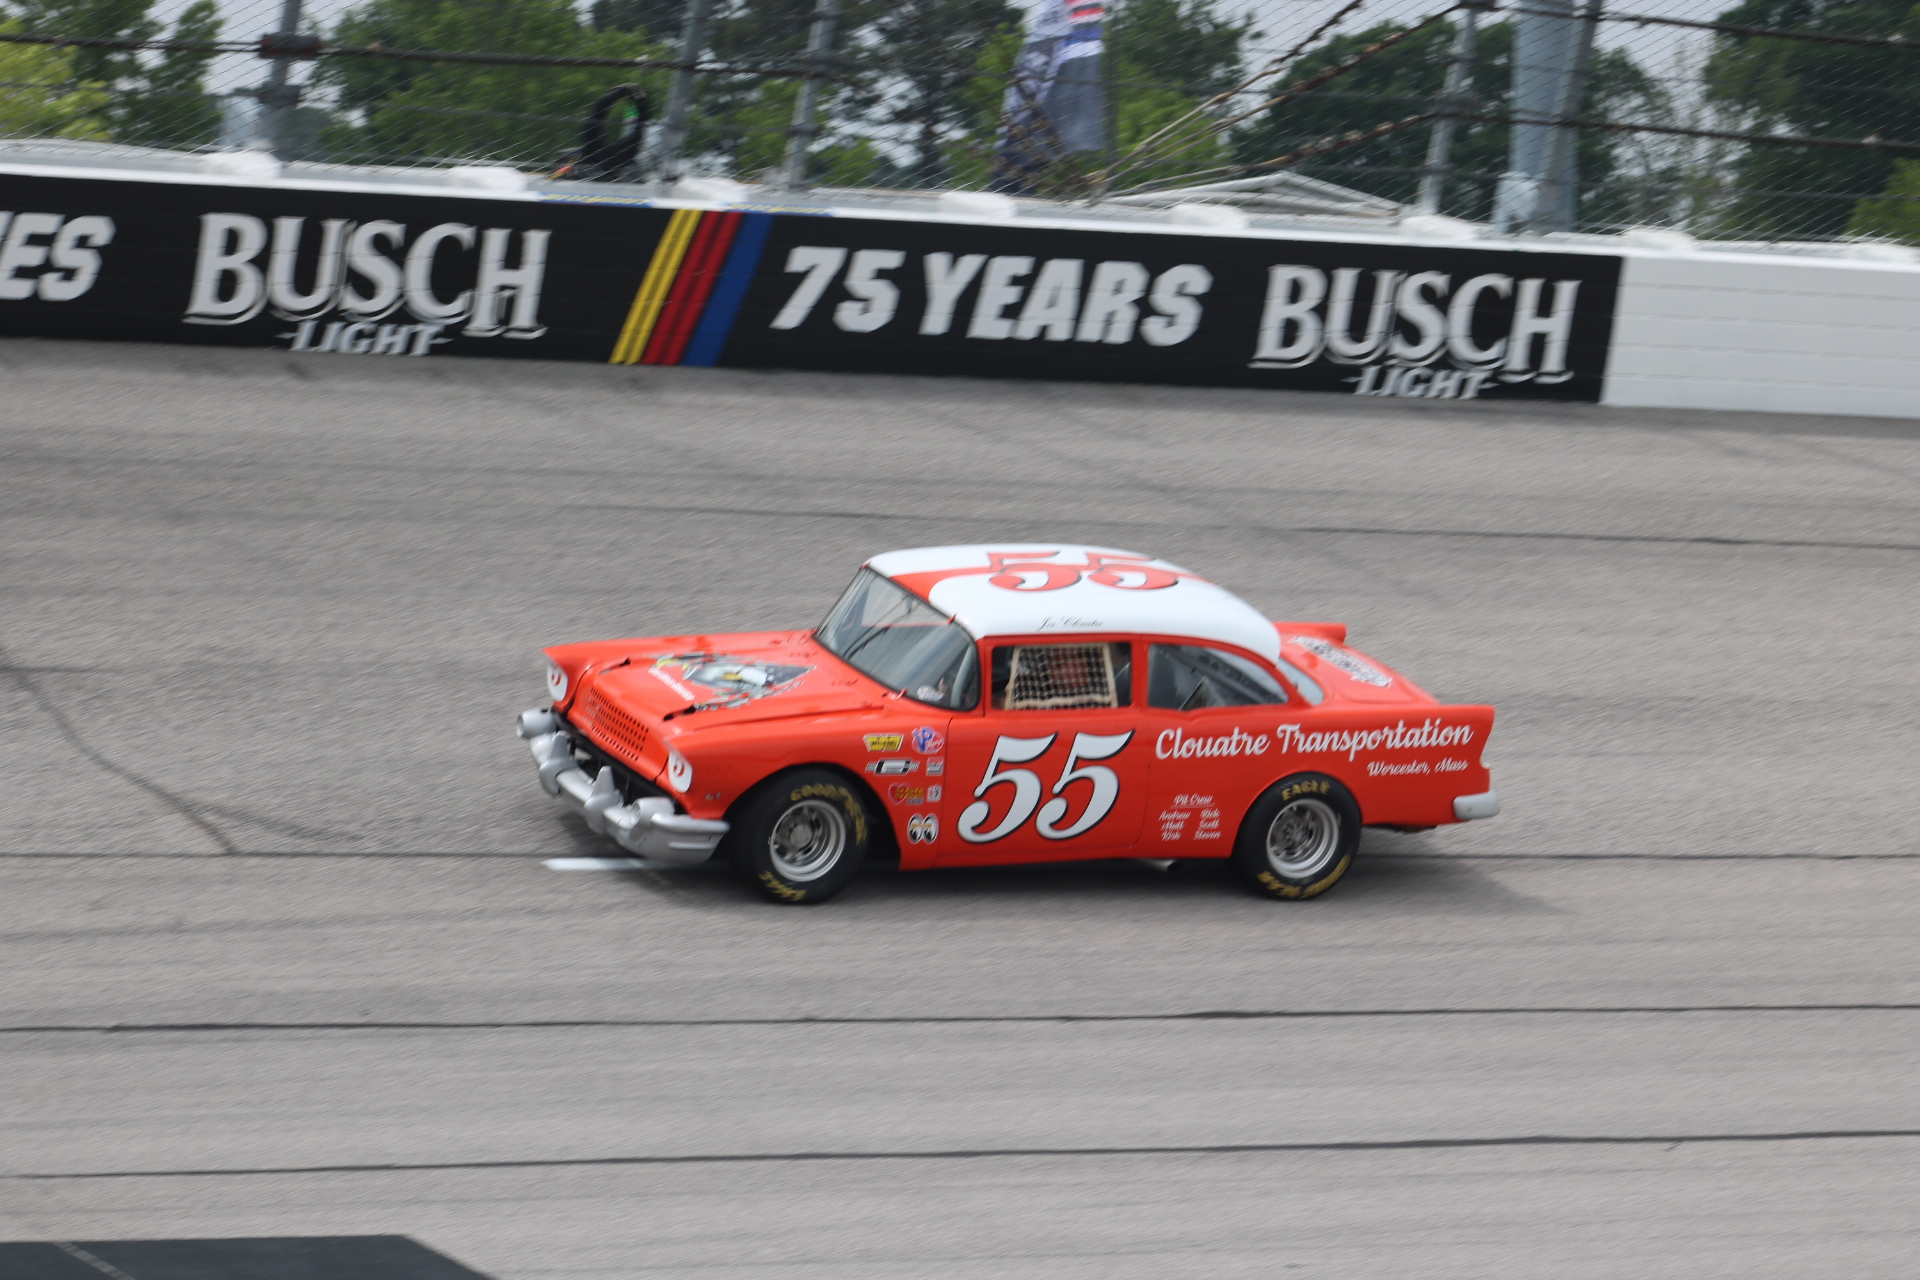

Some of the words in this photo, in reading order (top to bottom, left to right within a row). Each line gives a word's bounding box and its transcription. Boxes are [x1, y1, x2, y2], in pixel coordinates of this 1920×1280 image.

[182, 212, 552, 340] BUSCH
[769, 246, 906, 333] 75
[918, 251, 1213, 347] YEARS
[279, 320, 454, 356] LIGHT
[1249, 264, 1583, 385] BUSCH
[1342, 365, 1498, 400] LIGHT
[987, 550, 1180, 593] 55
[1155, 726, 1270, 760] Clouatre
[1277, 718, 1474, 762] Transportation
[1366, 759, 1431, 776] Worcester,
[1434, 757, 1469, 772] Mass
[957, 727, 1136, 844] 55
[1173, 793, 1190, 806] Pit
[1190, 792, 1214, 806] Crew
[1281, 780, 1331, 801] EAGLE
[1158, 809, 1192, 822] Andrew
[1198, 818, 1221, 831] Scott
[1193, 830, 1222, 841] Steven
